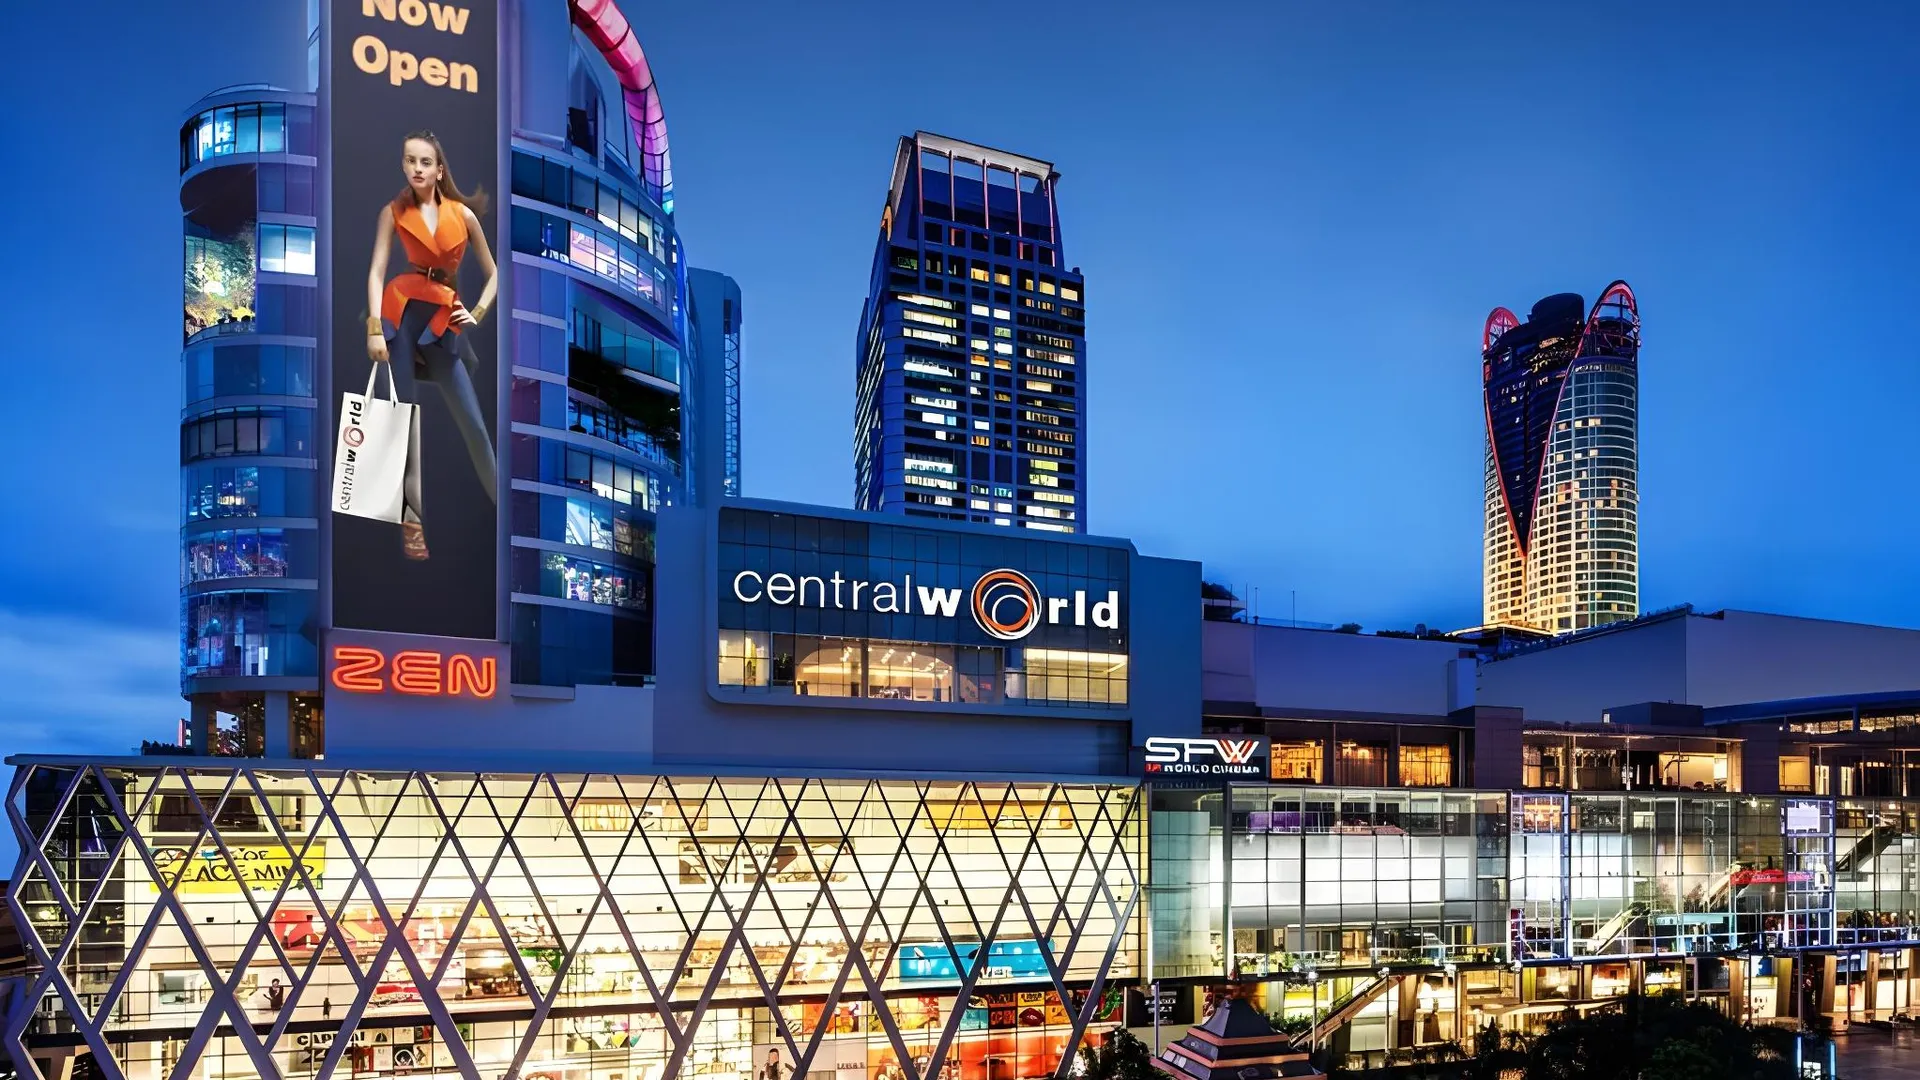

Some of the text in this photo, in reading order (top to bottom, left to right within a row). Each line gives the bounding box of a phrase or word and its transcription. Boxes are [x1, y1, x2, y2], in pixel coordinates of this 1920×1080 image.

[362, 0, 470, 35] Now
[352, 35, 478, 93] Open
[332, 646, 496, 697] ZEN
